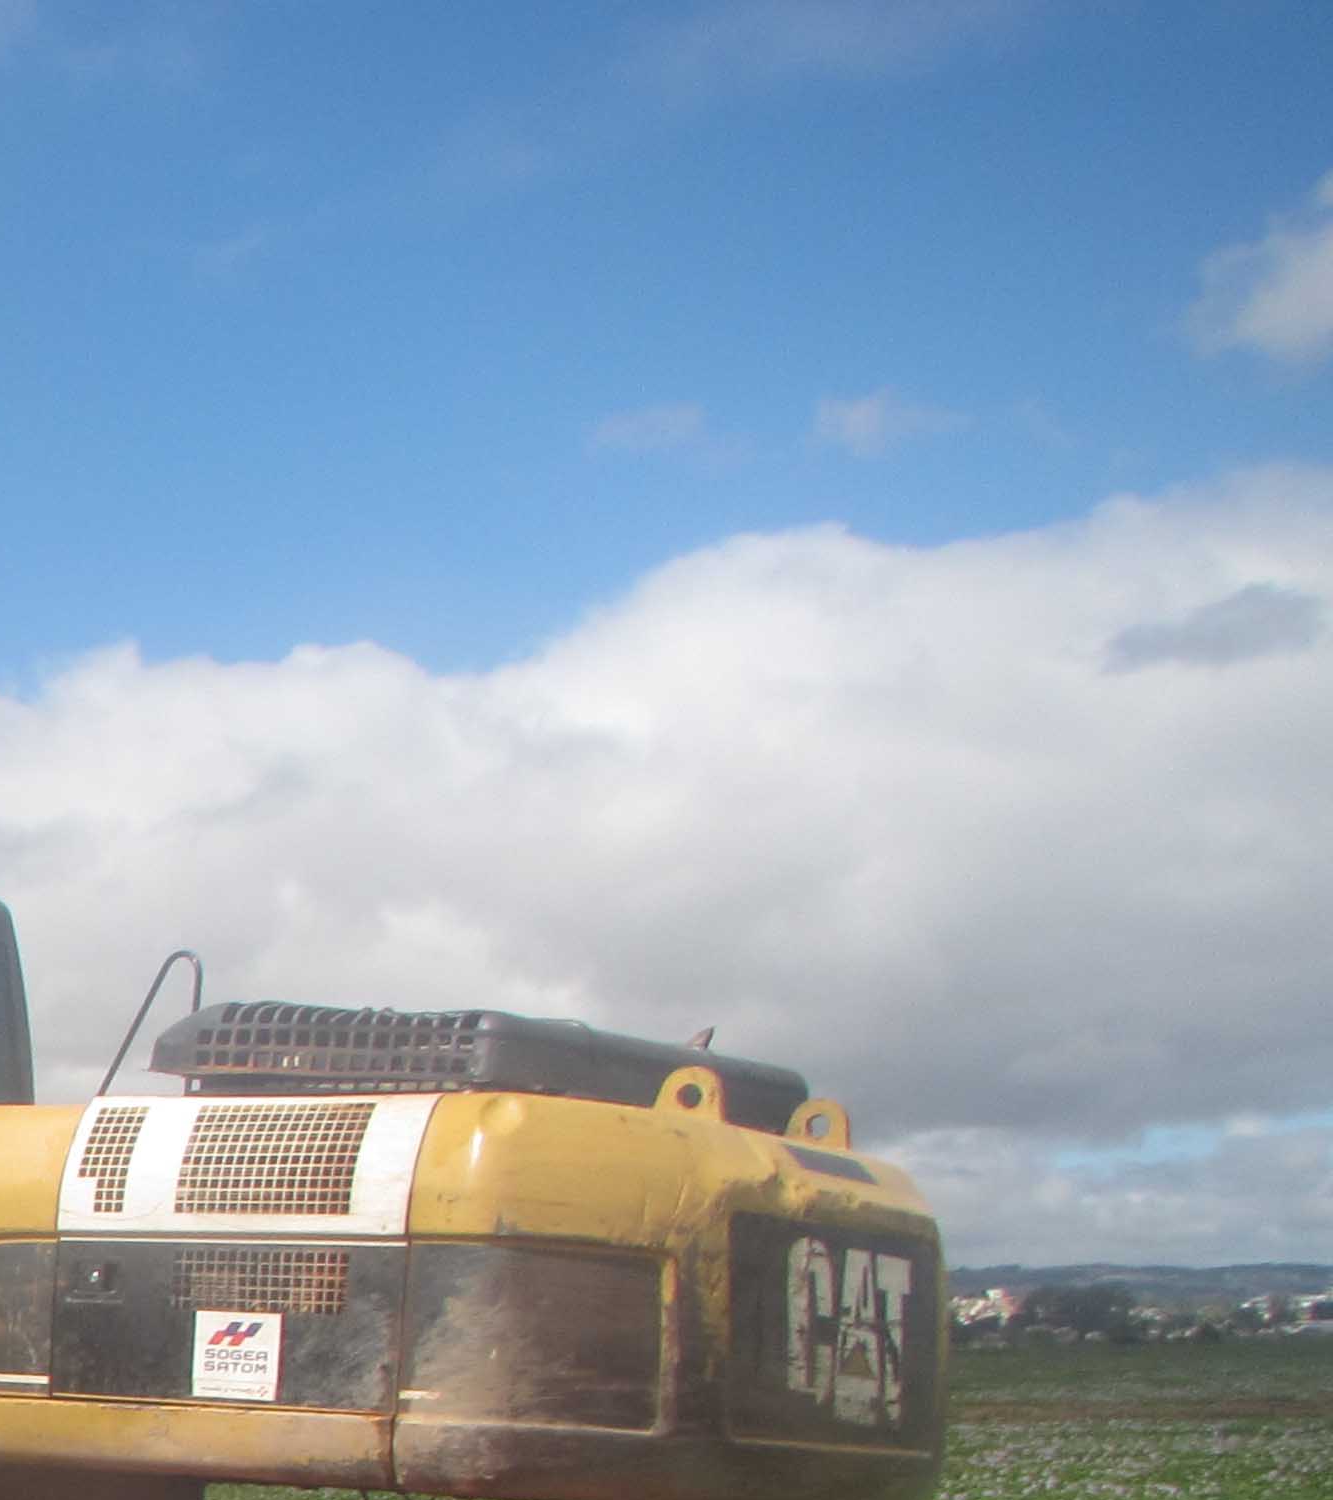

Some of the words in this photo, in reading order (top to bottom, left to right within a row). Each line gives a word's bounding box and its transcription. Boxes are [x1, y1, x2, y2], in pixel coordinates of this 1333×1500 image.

[785, 1236, 913, 1430] CAT
[204, 1348, 269, 1362] SOGEA
[203, 1360, 268, 1375] SATOM
